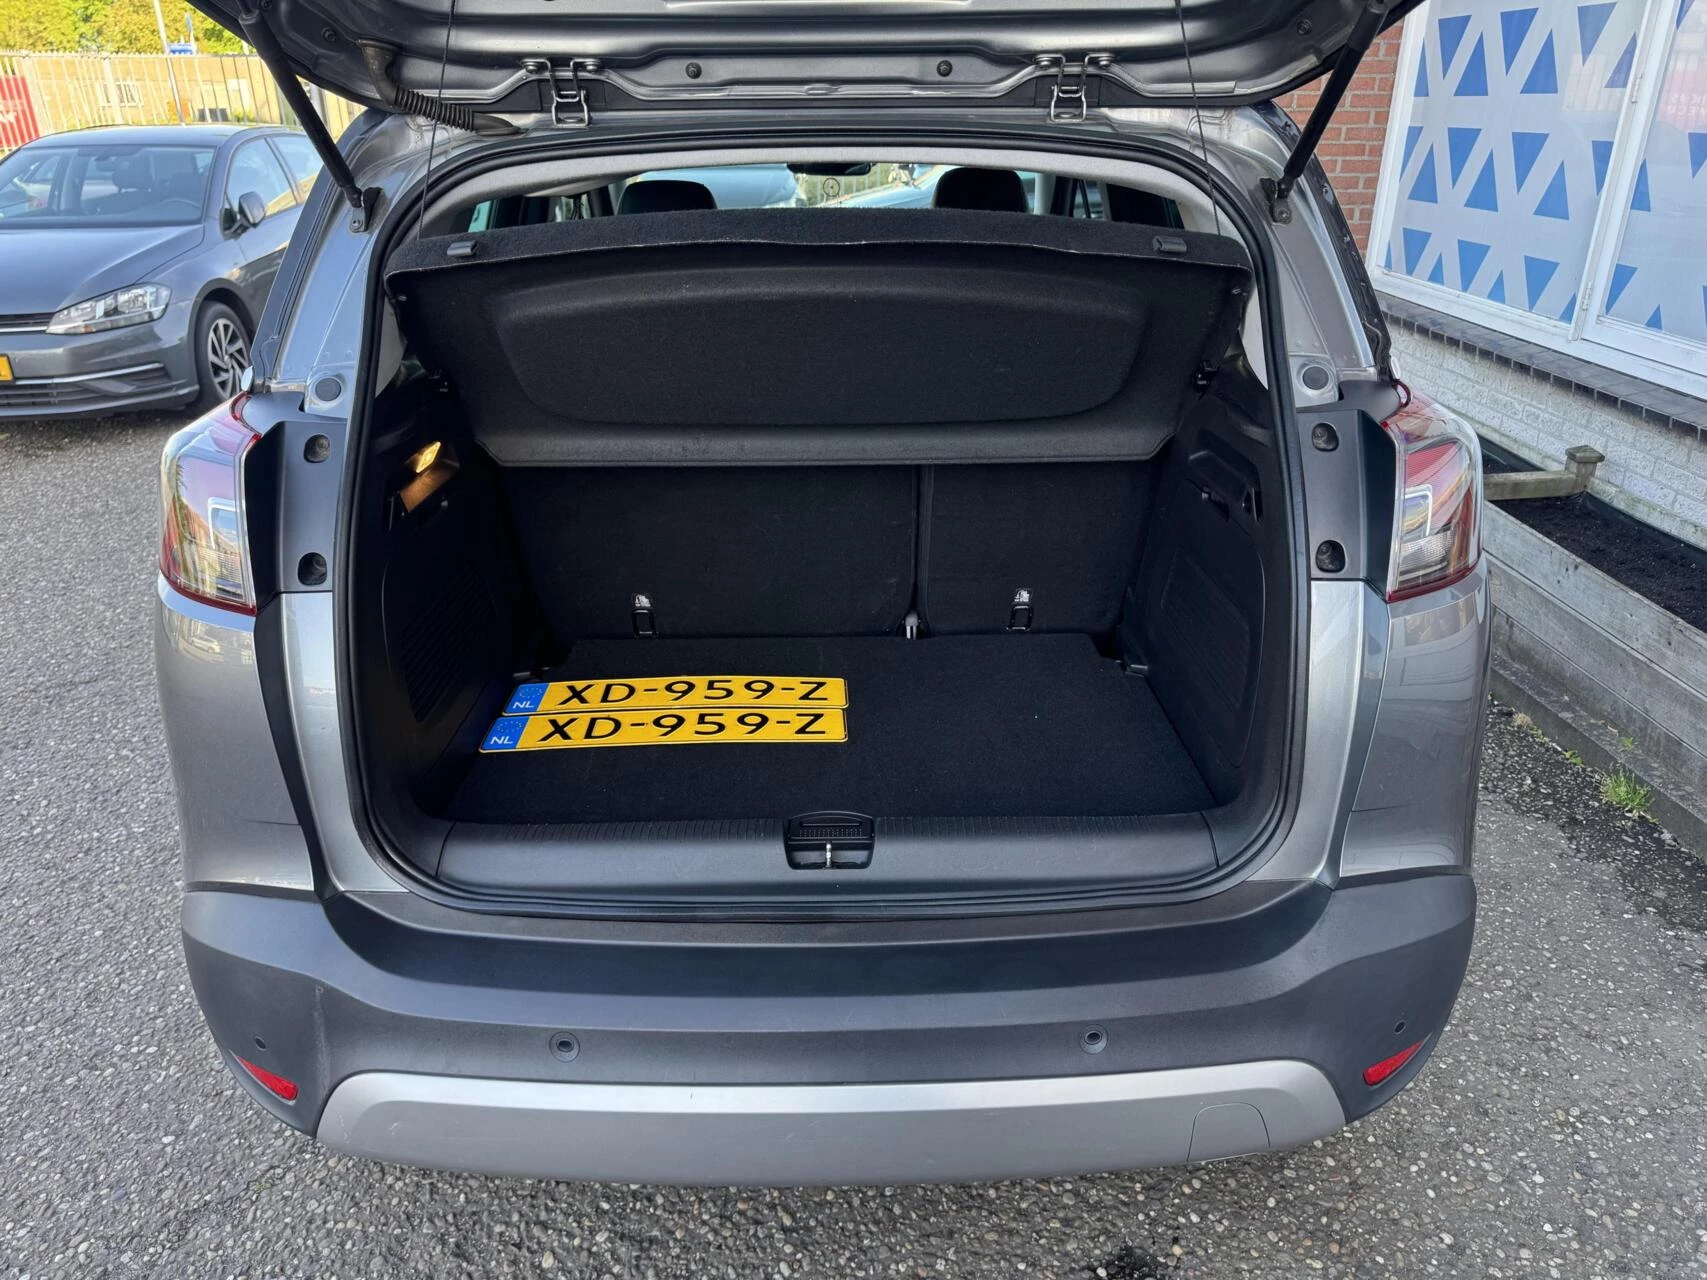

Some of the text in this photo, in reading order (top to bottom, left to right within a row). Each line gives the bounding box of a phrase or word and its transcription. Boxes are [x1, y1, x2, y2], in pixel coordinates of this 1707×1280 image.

[512, 679, 829, 709] NL XD-959-Z
[489, 712, 827, 745] NL XD-959-Z
